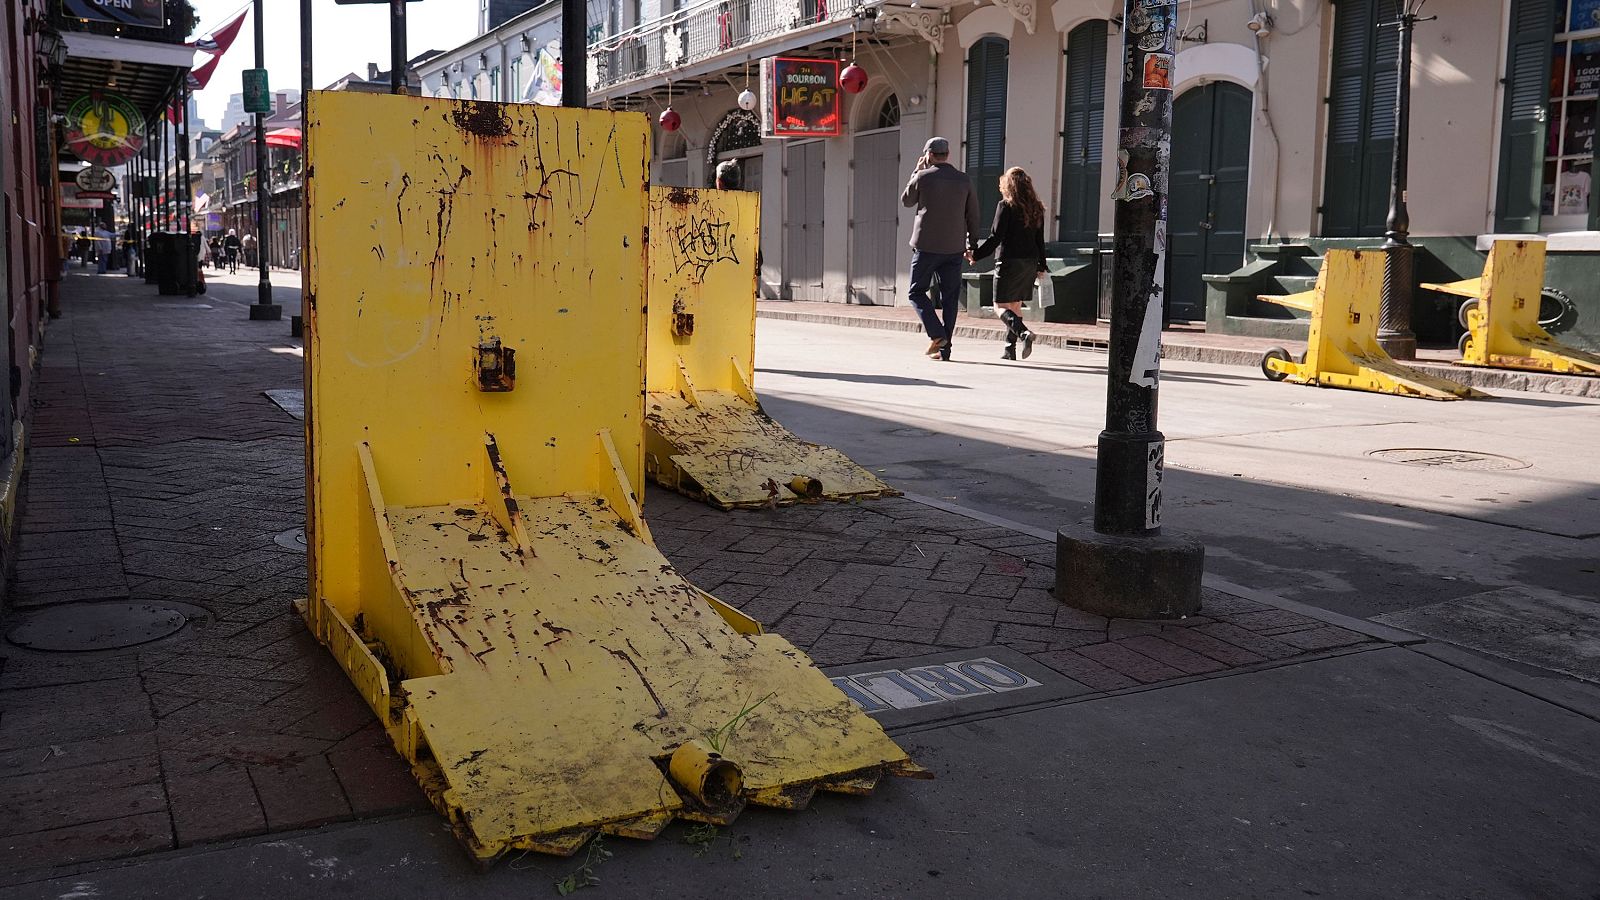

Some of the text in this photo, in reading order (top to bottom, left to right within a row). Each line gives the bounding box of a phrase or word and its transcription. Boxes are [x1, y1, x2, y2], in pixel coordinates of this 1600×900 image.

[787, 74, 827, 84] BOURBON
[781, 87, 834, 106] HEAT
[786, 115, 806, 126] GRILL
[820, 113, 836, 125] CLUB
